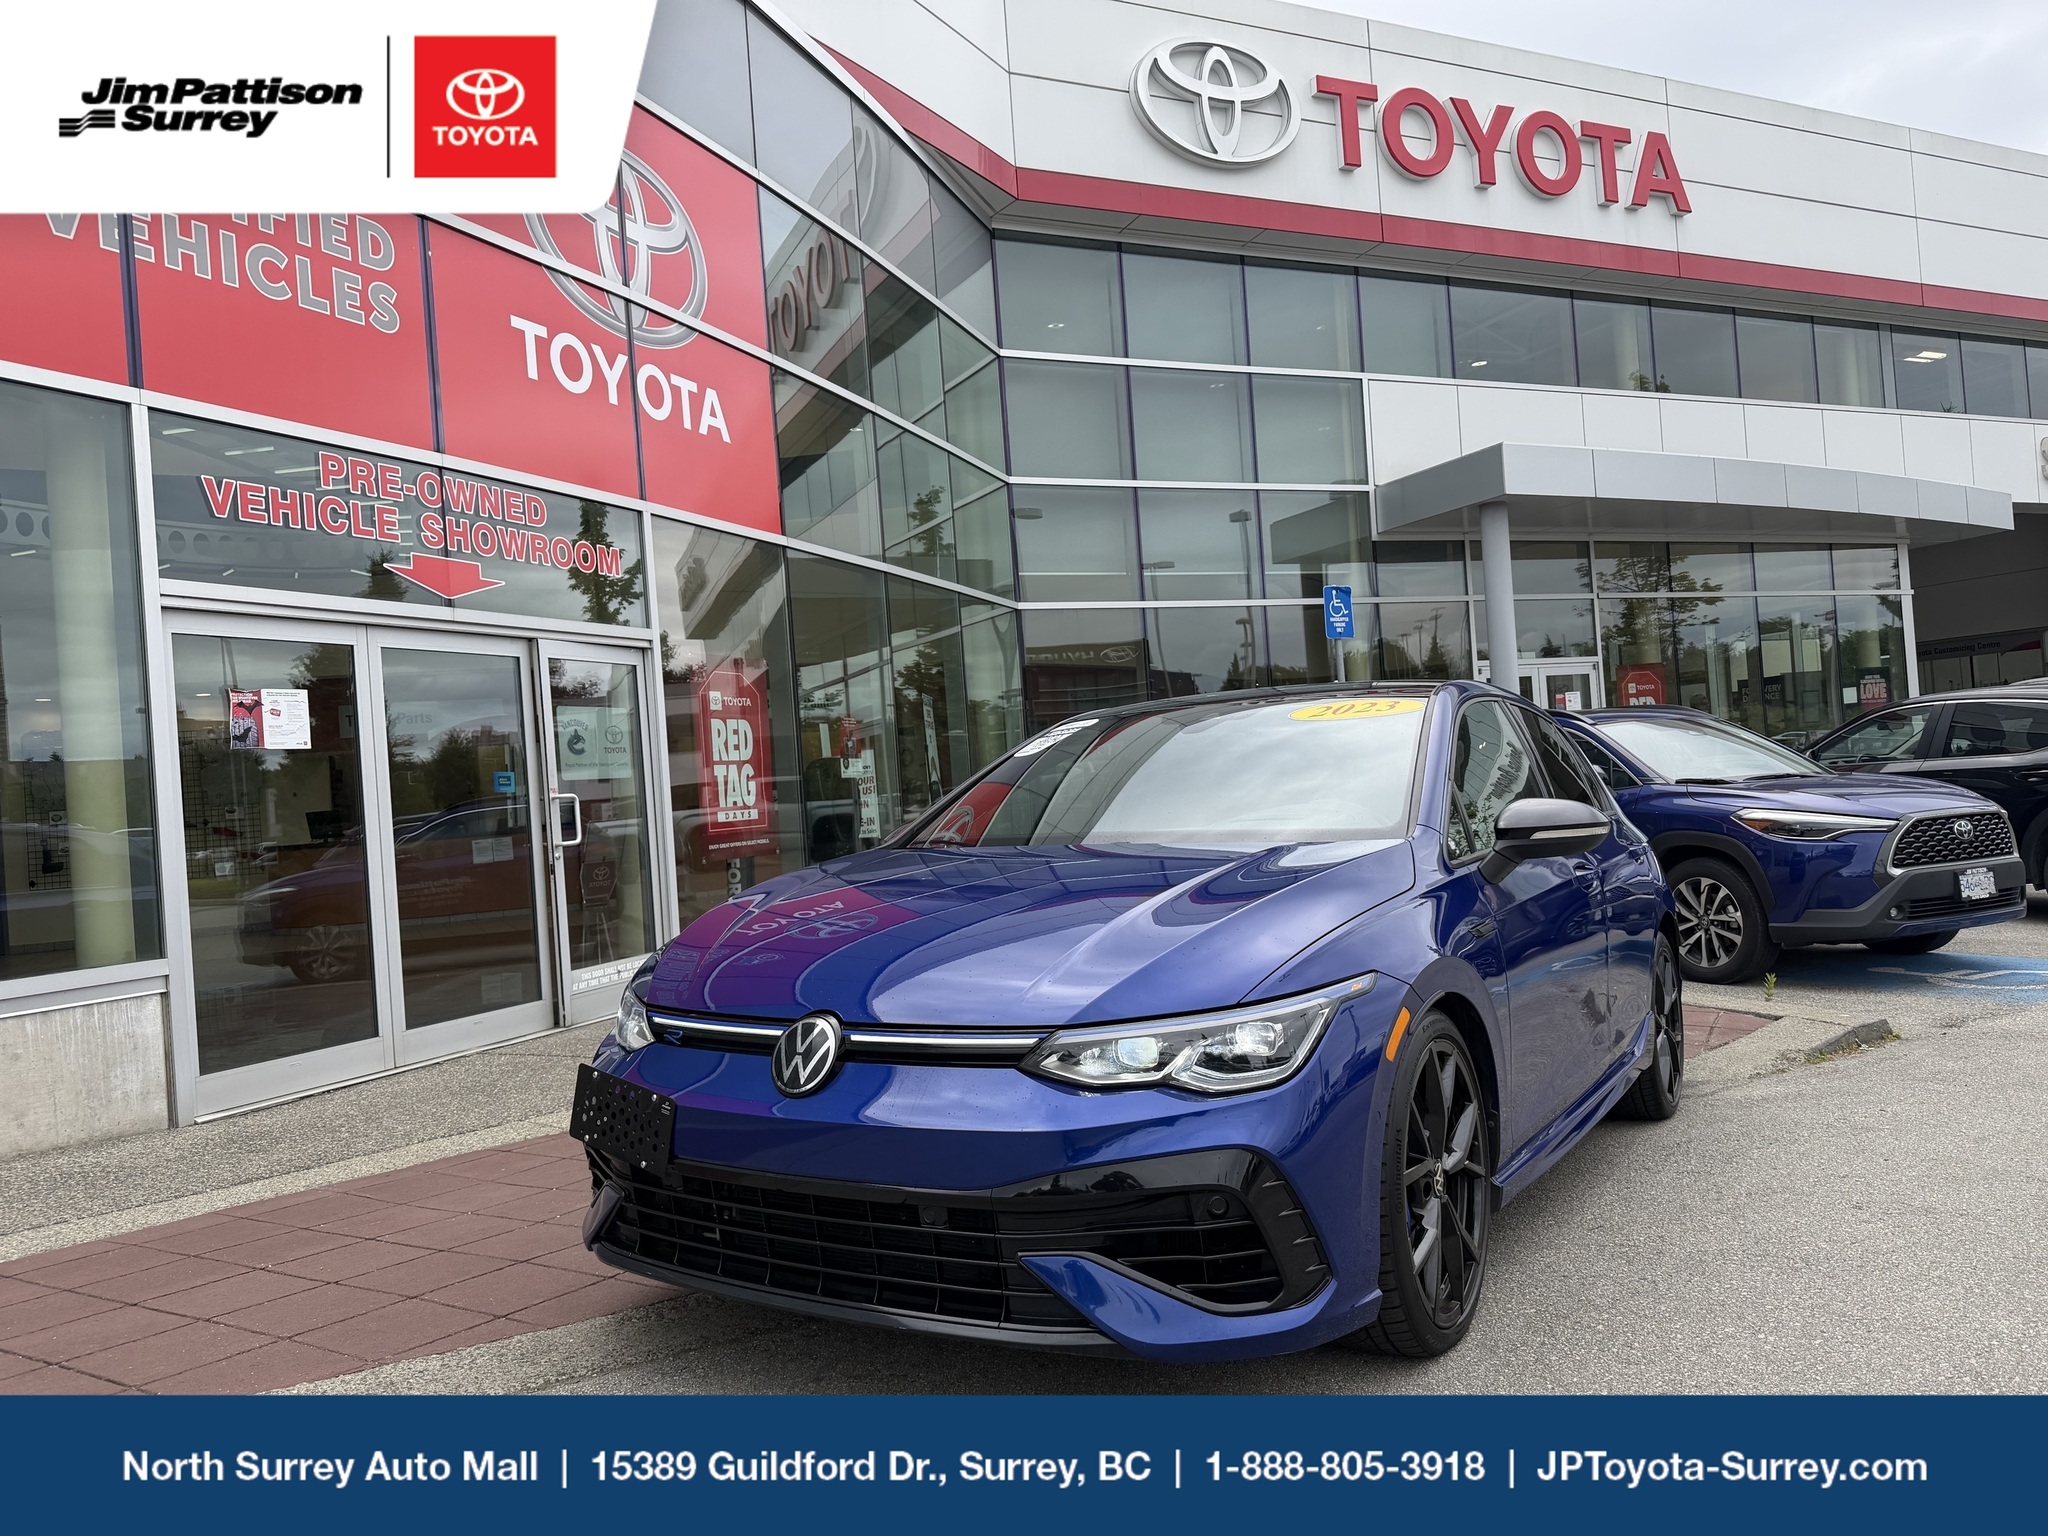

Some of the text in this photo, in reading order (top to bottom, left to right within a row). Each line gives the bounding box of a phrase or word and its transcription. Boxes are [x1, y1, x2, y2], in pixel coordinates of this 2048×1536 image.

[1310, 73, 1692, 216] TOYOTA
[510, 314, 731, 444] TOYOTA
[318, 450, 547, 527] PRE-OWNED
[200, 474, 622, 578] VEHICLE SHOWROOM
[1977, 641, 2000, 650] Centre
[1860, 682, 1887, 700] LOVE
[723, 696, 752, 706] TOYOTA
[1308, 700, 1400, 718] 2023
[397, 712, 432, 724] Parts
[561, 719, 589, 731] VANCOUVER
[711, 718, 754, 762] RED
[713, 763, 756, 808] TAG
[862, 786, 876, 795] US!
[725, 811, 752, 820] DAYS
[592, 970, 604, 978] DOOR
[579, 980, 588, 989] ANY
[588, 978, 599, 987] TIME
[600, 976, 610, 984] THAT
